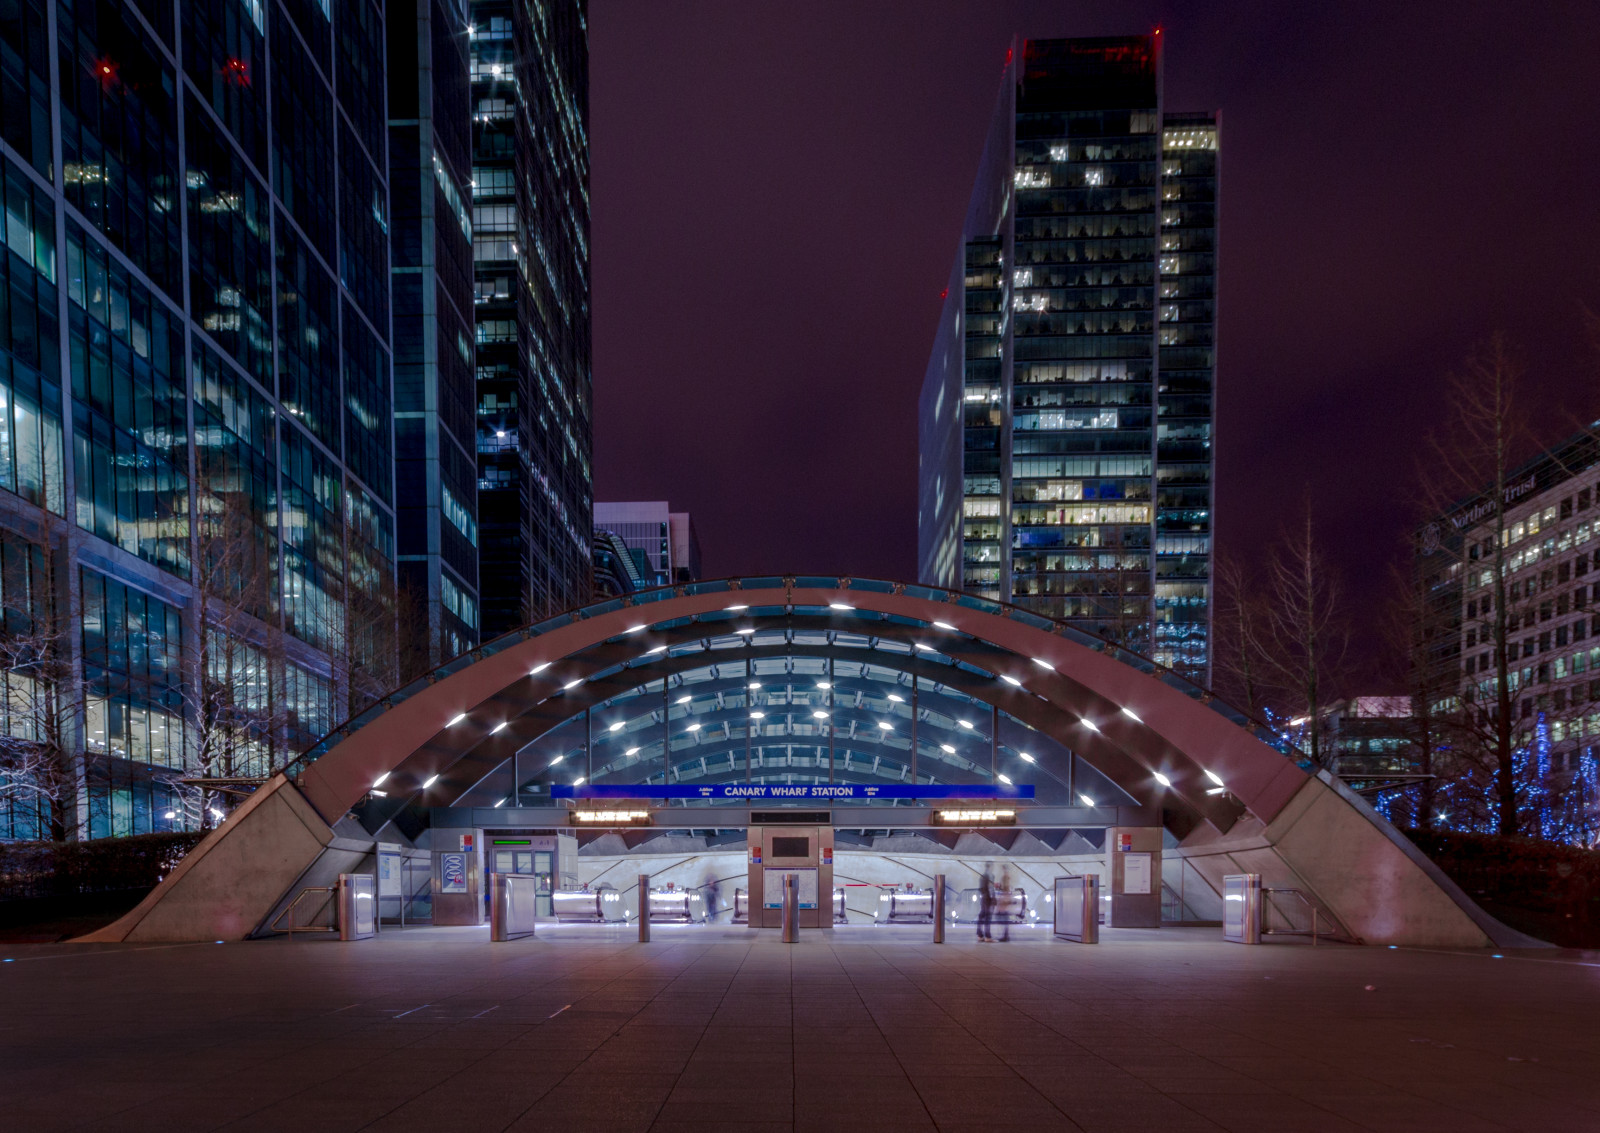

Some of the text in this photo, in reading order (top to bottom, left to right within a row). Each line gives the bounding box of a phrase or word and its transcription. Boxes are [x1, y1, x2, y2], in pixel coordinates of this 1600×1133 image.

[1502, 474, 1536, 503] Trust
[725, 787, 853, 796] CANARY WHARF STATION
